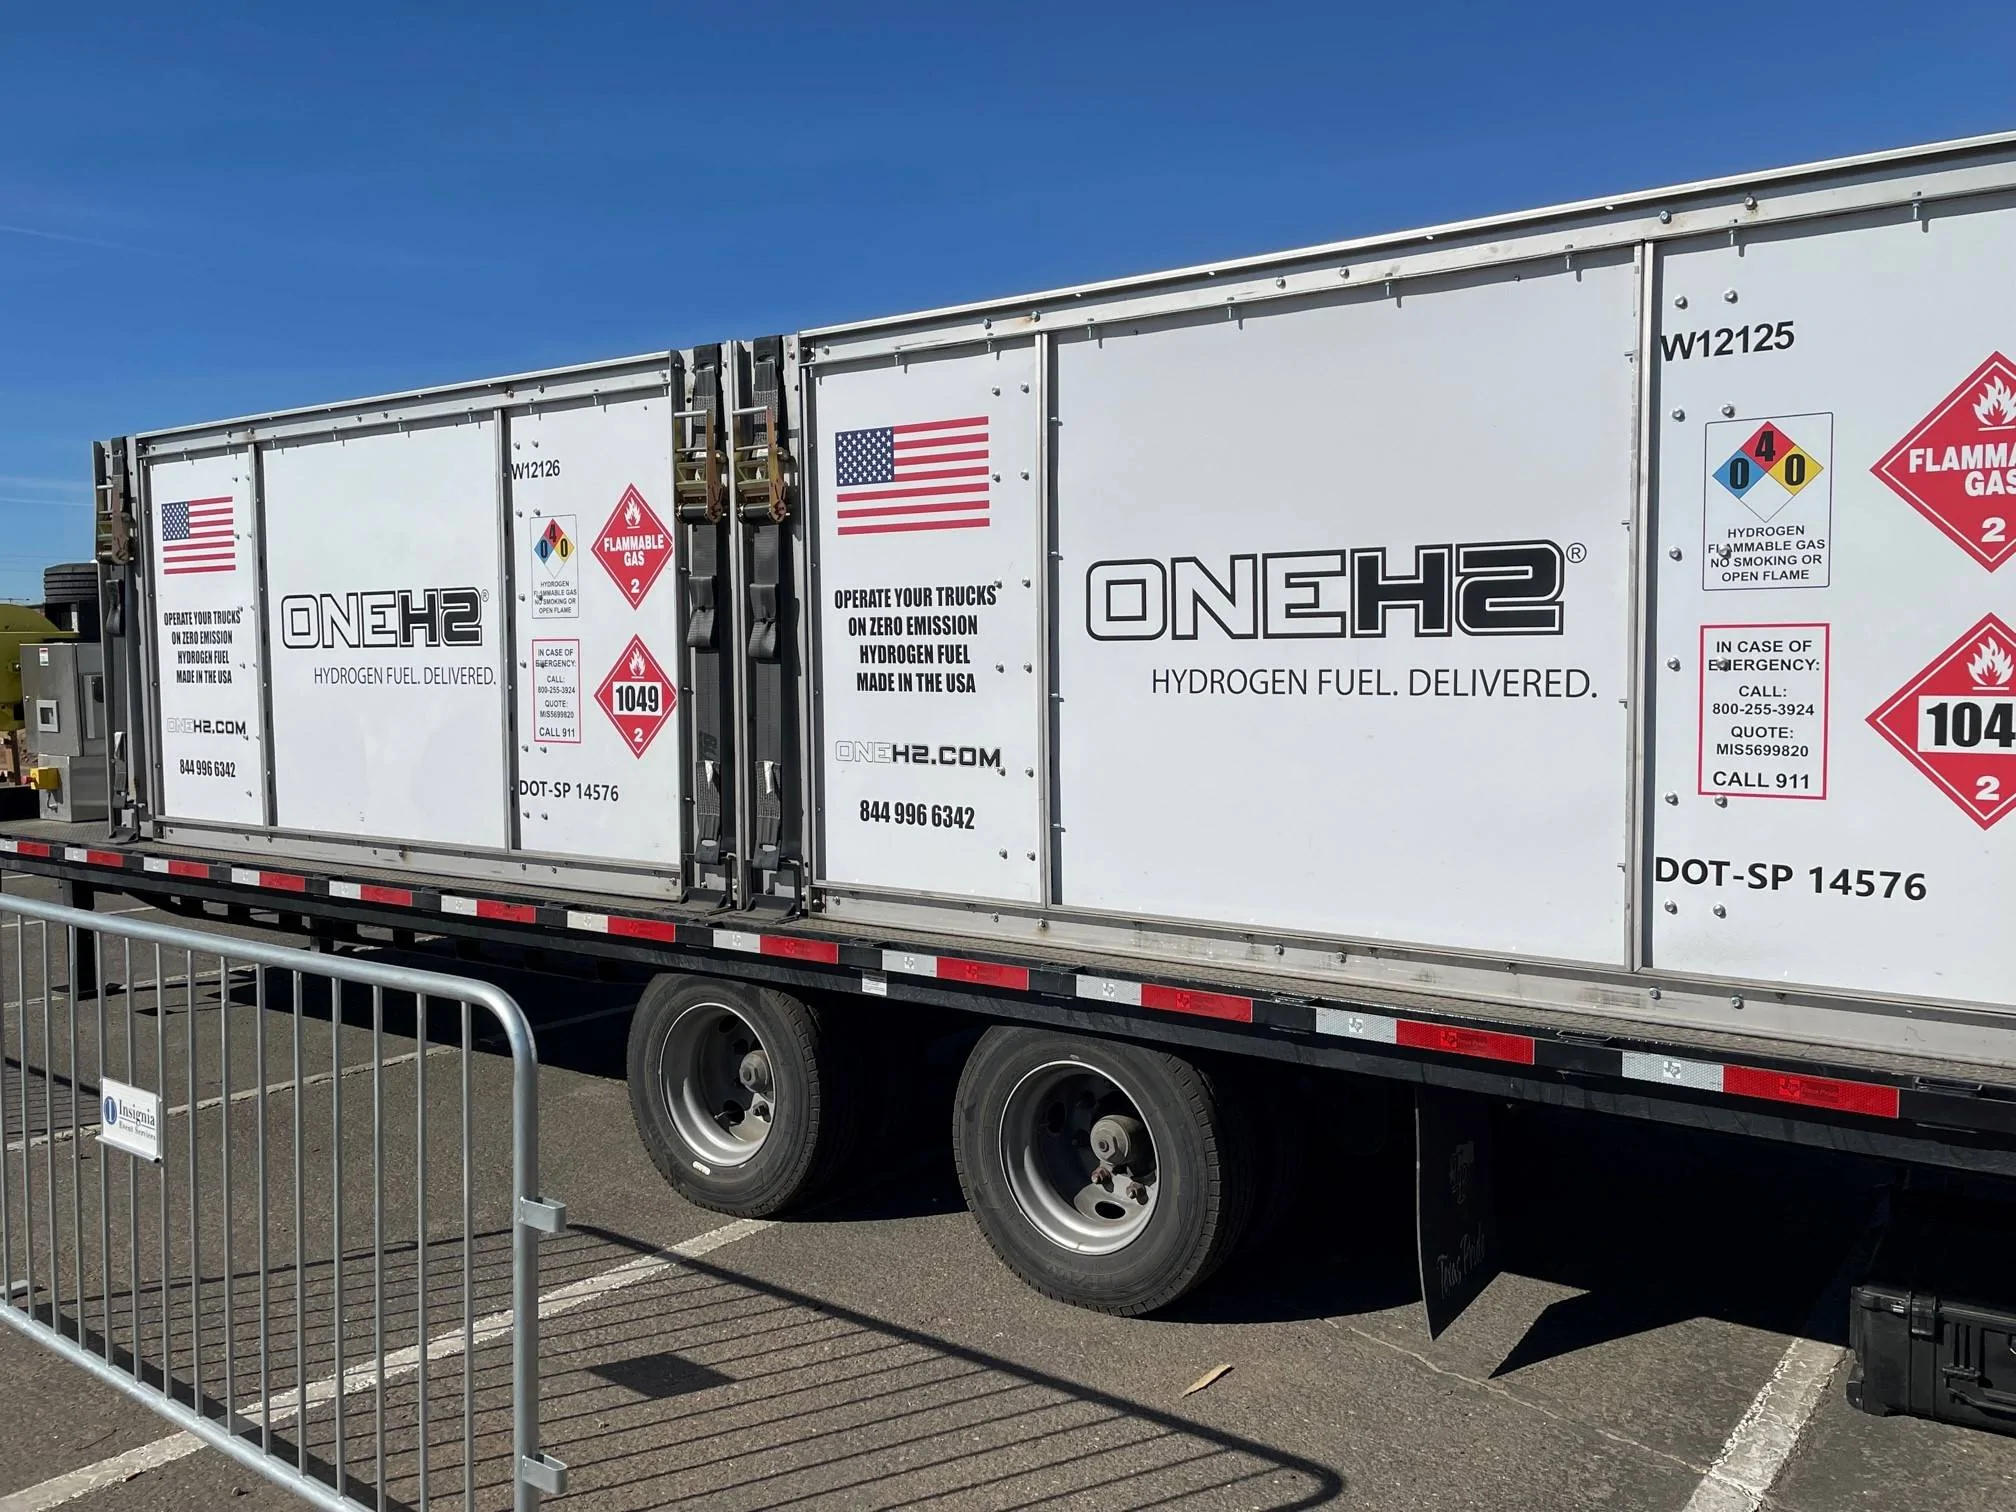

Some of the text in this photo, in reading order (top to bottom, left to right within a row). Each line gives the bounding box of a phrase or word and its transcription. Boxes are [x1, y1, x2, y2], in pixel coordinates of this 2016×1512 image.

[1661, 320, 1795, 362] W12125
[1755, 430, 1776, 462] 4
[511, 459, 561, 480] W12126
[1729, 453, 1806, 490] 0 0
[549, 524, 557, 543] 4
[1727, 525, 1805, 539] HYDROGEN
[1981, 516, 2007, 543] 2
[540, 538, 568, 559] 0 0
[603, 534, 665, 553] FLAMMABLE
[1795, 539, 1826, 550] GAS
[623, 551, 645, 567] GAS
[1710, 554, 1823, 569] NO SMOKING OR
[540, 580, 570, 588] HYDROGEN
[1721, 569, 1810, 582] OPEN FLAME
[630, 578, 640, 593] 2
[834, 584, 997, 610] OPERATE YOUR TRUCKS
[163, 609, 242, 627] OPERATE YOUR TRUCKS
[554, 606, 572, 614] FLAME
[849, 614, 978, 637] ON ZERO EMISSION
[171, 630, 233, 645] ON ZERO EMISSION
[1716, 640, 1812, 653] IN CASE OF
[177, 650, 230, 665] HYDROGEN FUEL
[537, 648, 574, 656] IN CASE OF
[859, 643, 971, 665] HYDROGEN FUEL
[176, 669, 232, 684] MADE IN THE USA
[313, 666, 497, 686] HYDROGEN FUEL. DELIVERED.
[546, 675, 566, 684] CALL:
[856, 671, 977, 694] MADE IN THE USA
[1151, 668, 1598, 699] HYDROGEN FUEL. DELIVERED.
[537, 686, 576, 694] 800-255-3924
[615, 685, 660, 713] 1049
[1738, 685, 1787, 697] CALL:
[544, 699, 569, 708] QUOTE:
[1712, 703, 1815, 716] 800-255-3924
[166, 717, 247, 735] ONEH2.COM
[539, 727, 576, 738] CALL 911
[633, 727, 644, 743] 2
[1730, 726, 1794, 739] QUOTE:
[835, 740, 1001, 768] ONEH2.COM
[1716, 743, 1810, 757] MIS5699820
[179, 758, 236, 778] 844 996 6342
[1712, 771, 1809, 789] CALL 911
[1975, 774, 2001, 801] 2
[520, 779, 619, 802] DOT-SP 14576
[859, 799, 975, 830] 844 996 6342
[1655, 856, 1927, 901] DOT-SP 14576
[118, 1099, 156, 1126] Insignia
